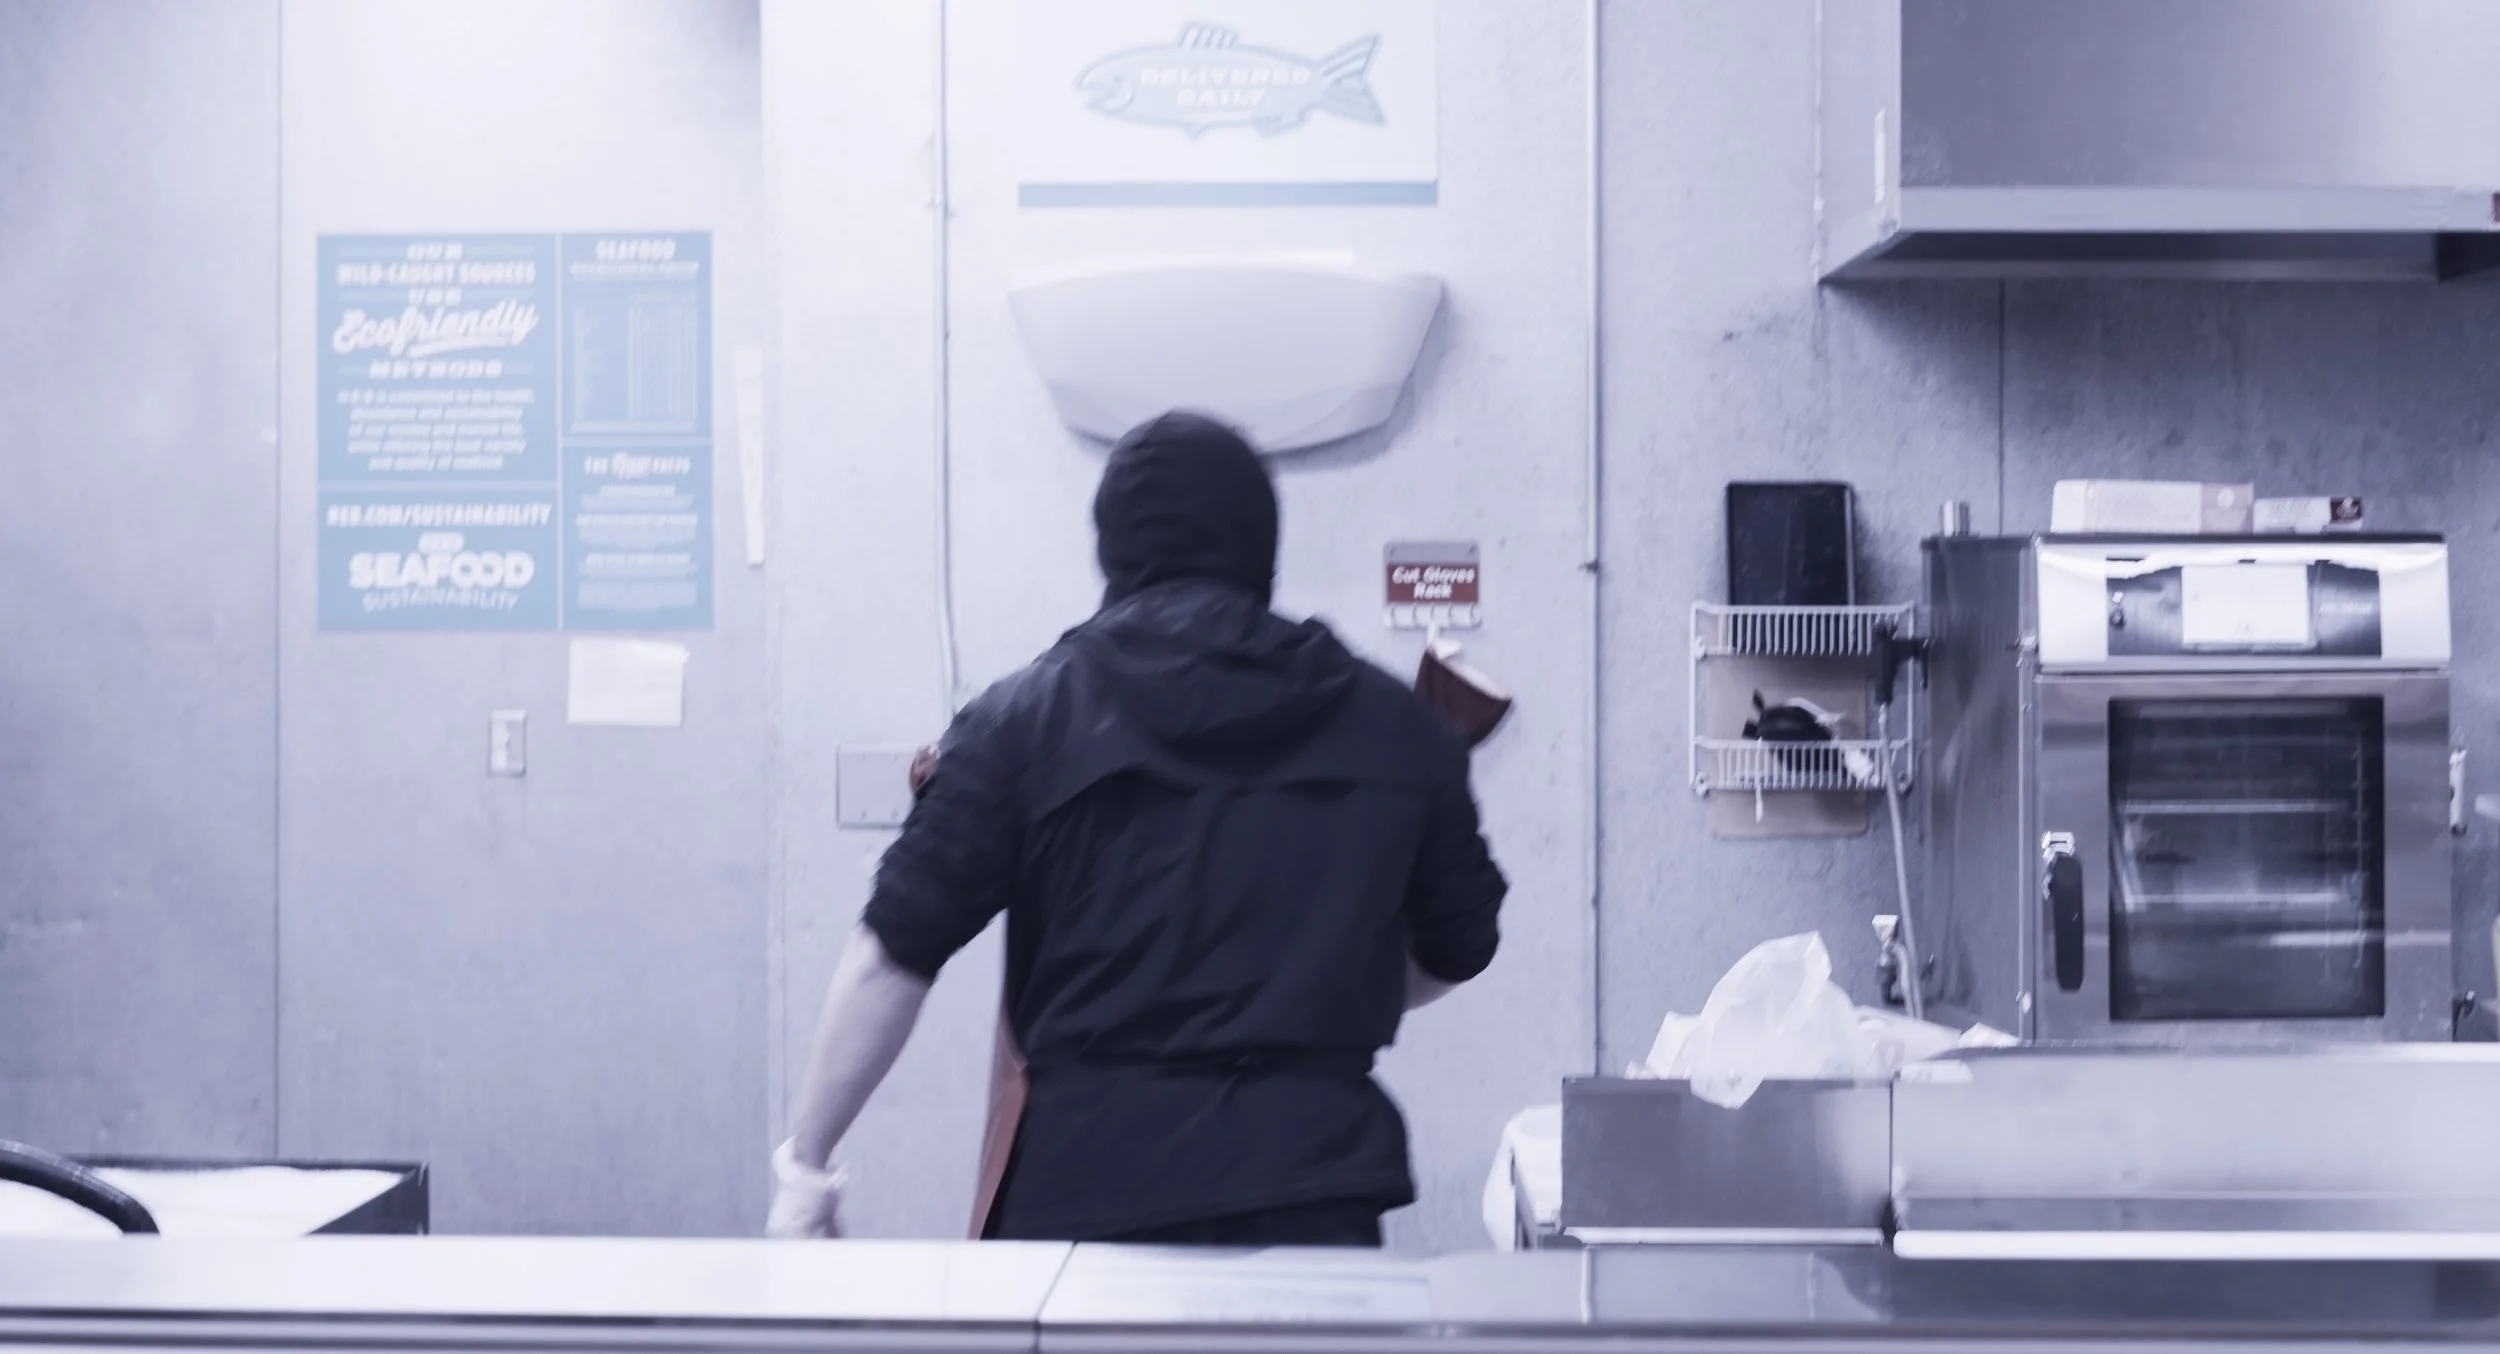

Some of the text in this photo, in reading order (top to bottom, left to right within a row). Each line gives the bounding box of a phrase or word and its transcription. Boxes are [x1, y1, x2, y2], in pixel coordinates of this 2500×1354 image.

[1140, 66, 1312, 86] DELIVERED
[1176, 88, 1267, 107] DAILY
[595, 238, 677, 260] SEAFOOD
[336, 261, 537, 286] WILD-CAUGHT SOURCES
[332, 299, 540, 355] Ecofriendly
[370, 359, 503, 380] METHODS
[326, 503, 552, 527] HEB.COM/SUSTAINABILITY
[349, 551, 535, 589] SEAFOOD
[1392, 565, 1476, 584] Cut Gloves
[362, 588, 520, 613] SUSTAINABILITY
[1413, 581, 1453, 599] Rack
